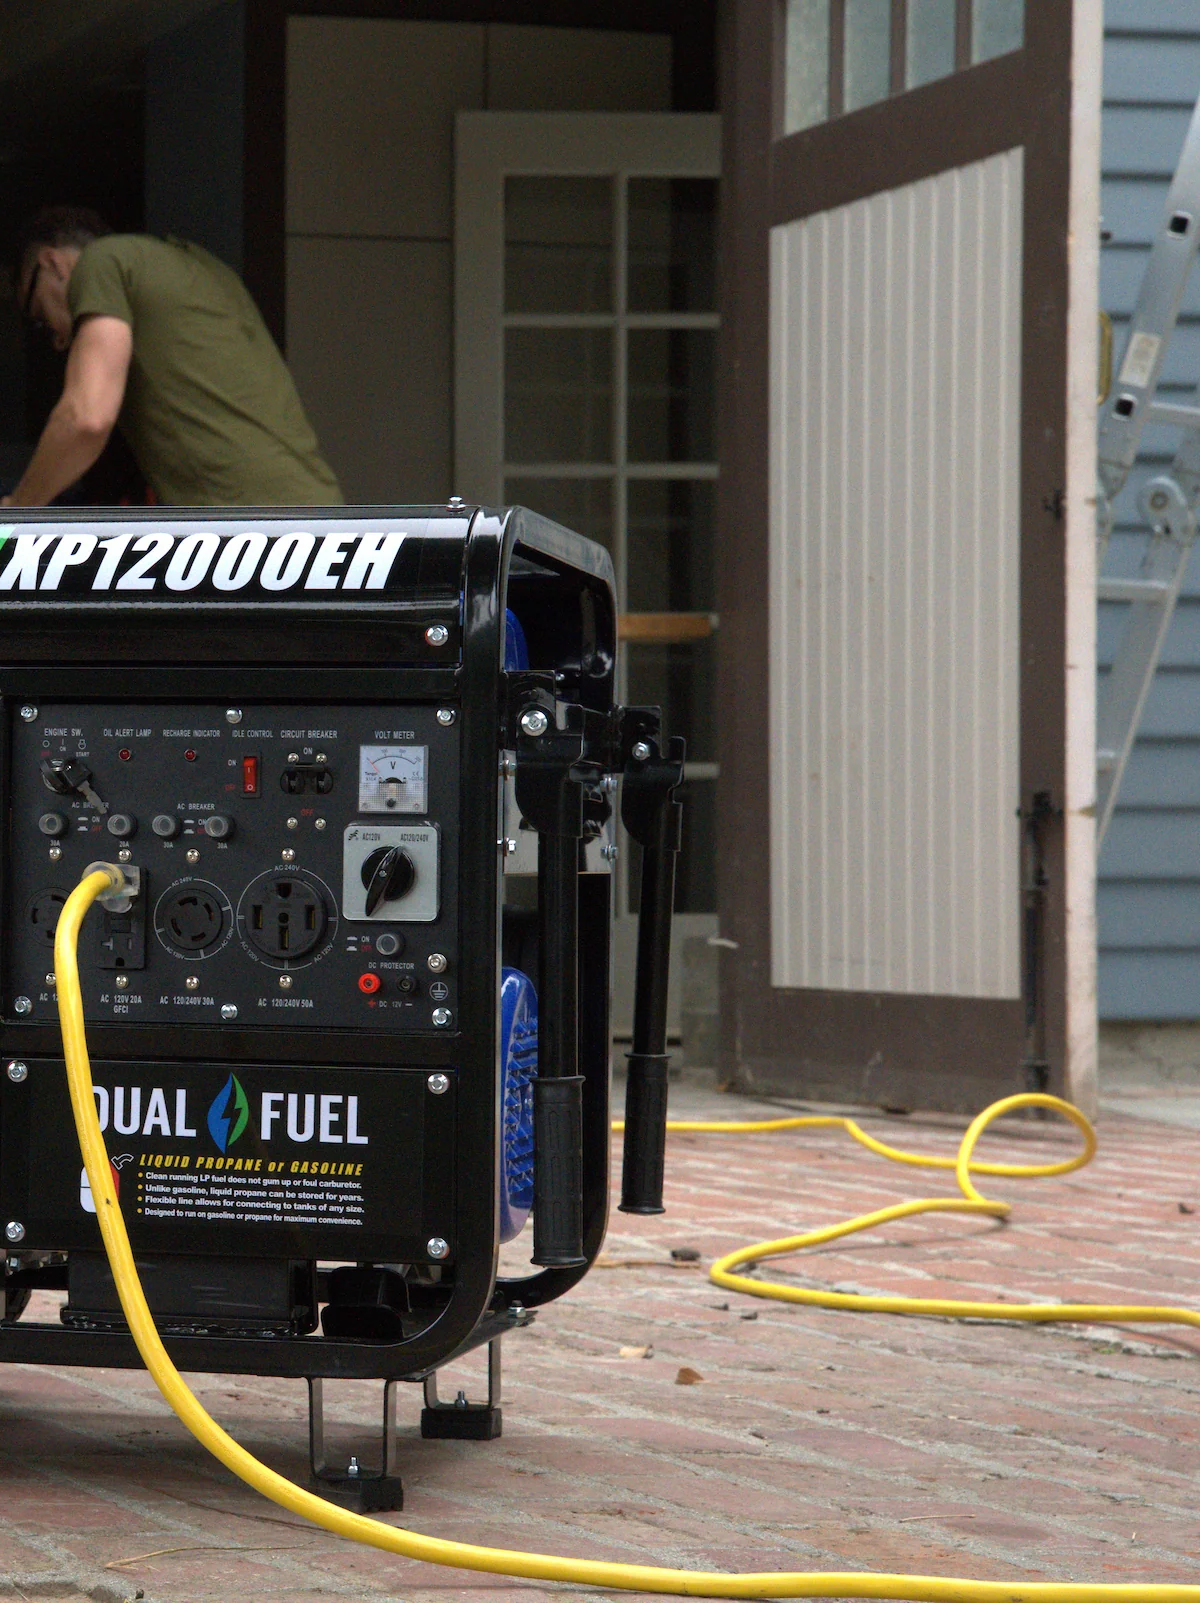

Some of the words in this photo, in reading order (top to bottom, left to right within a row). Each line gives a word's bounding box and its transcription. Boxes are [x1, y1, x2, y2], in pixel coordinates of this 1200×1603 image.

[44, 728, 68, 736] ENGINE
[115, 729, 133, 737] ALERT
[136, 729, 152, 737] LAMP
[280, 730, 305, 738] CIRCUIT
[308, 731, 338, 739] BREAKER
[375, 731, 391, 739] VOLT
[393, 731, 415, 739] METER
[140, 1154, 190, 1168] LIQUID
[195, 1157, 262, 1171] PROPANE
[268, 1161, 285, 1172] or
[291, 1161, 363, 1176] GASOLINE
[146, 1172, 167, 1180] Clean
[169, 1173, 198, 1183] running
[227, 1175, 246, 1183] does
[262, 1178, 279, 1187] gum
[281, 1179, 291, 1187] up
[318, 1179, 361, 1188] carburetor.
[146, 1184, 170, 1192] Unlike
[172, 1185, 208, 1196] gasoline,
[210, 1187, 232, 1197] liquid
[234, 1189, 266, 1198] propane
[298, 1190, 324, 1199] stored
[338, 1194, 363, 1202] years.
[146, 1195, 176, 1204] Flexible
[194, 1197, 221, 1206] allows
[236, 1199, 281, 1210] connecting
[293, 1202, 316, 1210] tanks
[328, 1205, 344, 1213] any
